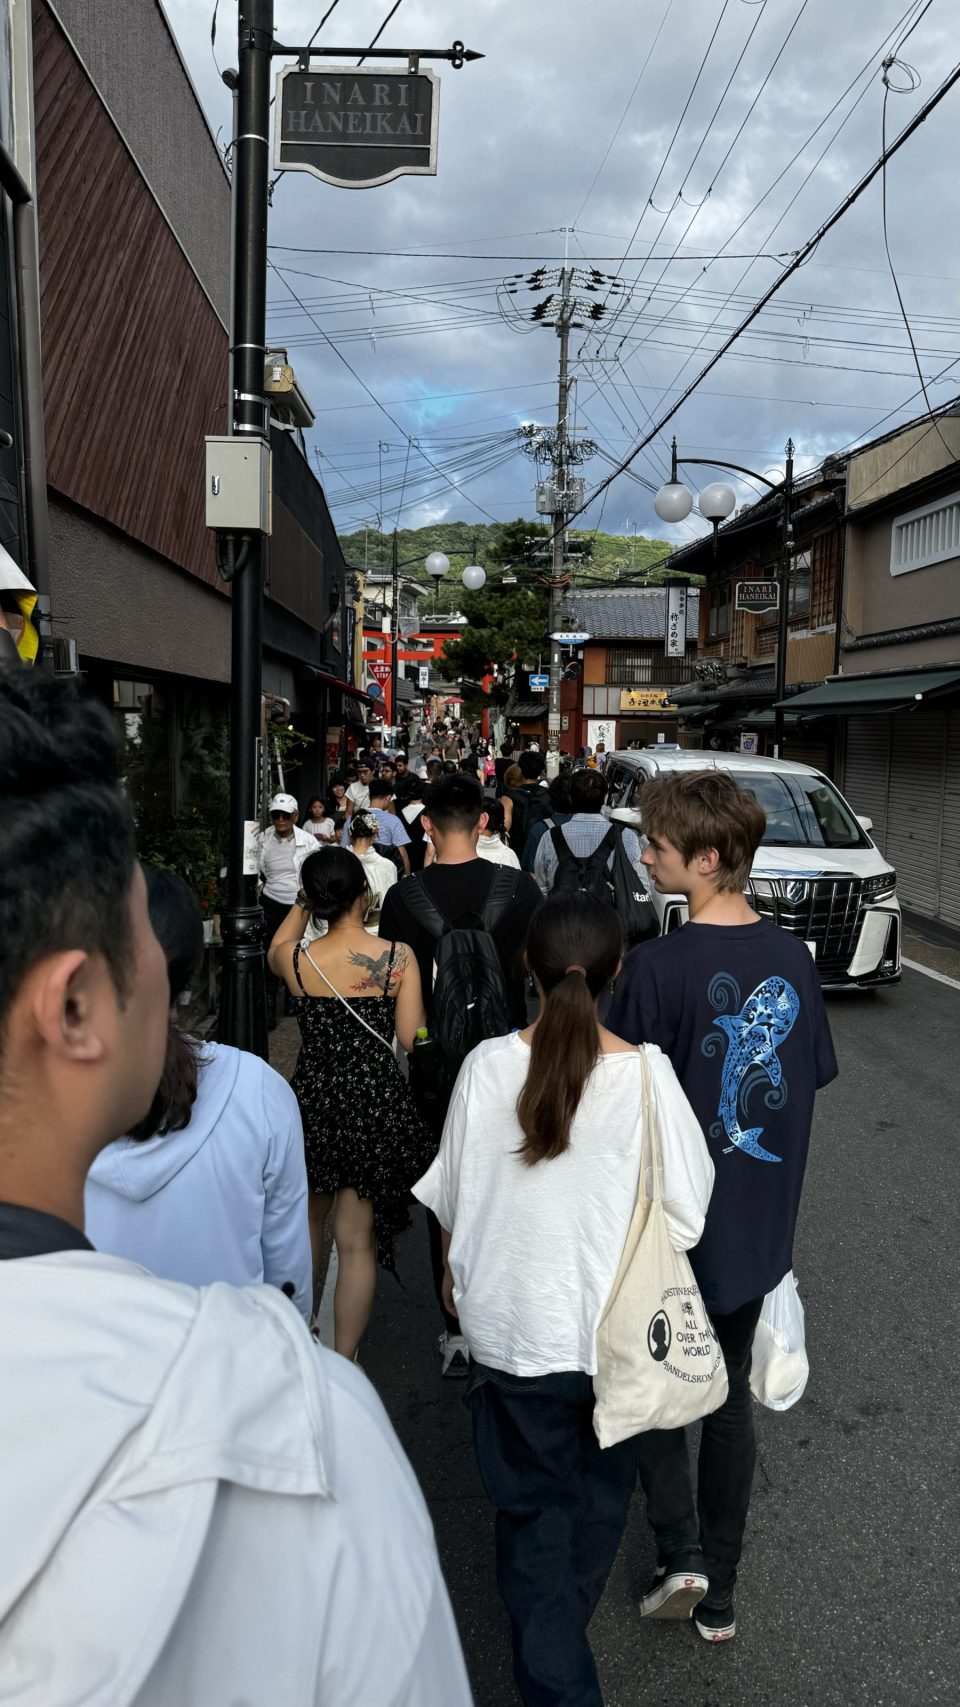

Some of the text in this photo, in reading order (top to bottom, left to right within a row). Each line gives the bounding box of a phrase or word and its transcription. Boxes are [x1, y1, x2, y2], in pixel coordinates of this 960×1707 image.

[303, 82, 410, 107] INARI
[286, 110, 425, 135] HANEIKAI
[743, 585, 772, 593] INARI
[685, 1320, 698, 1330] ALL
[676, 1332, 696, 1344] OVER
[682, 1344, 712, 1357] WORLD
